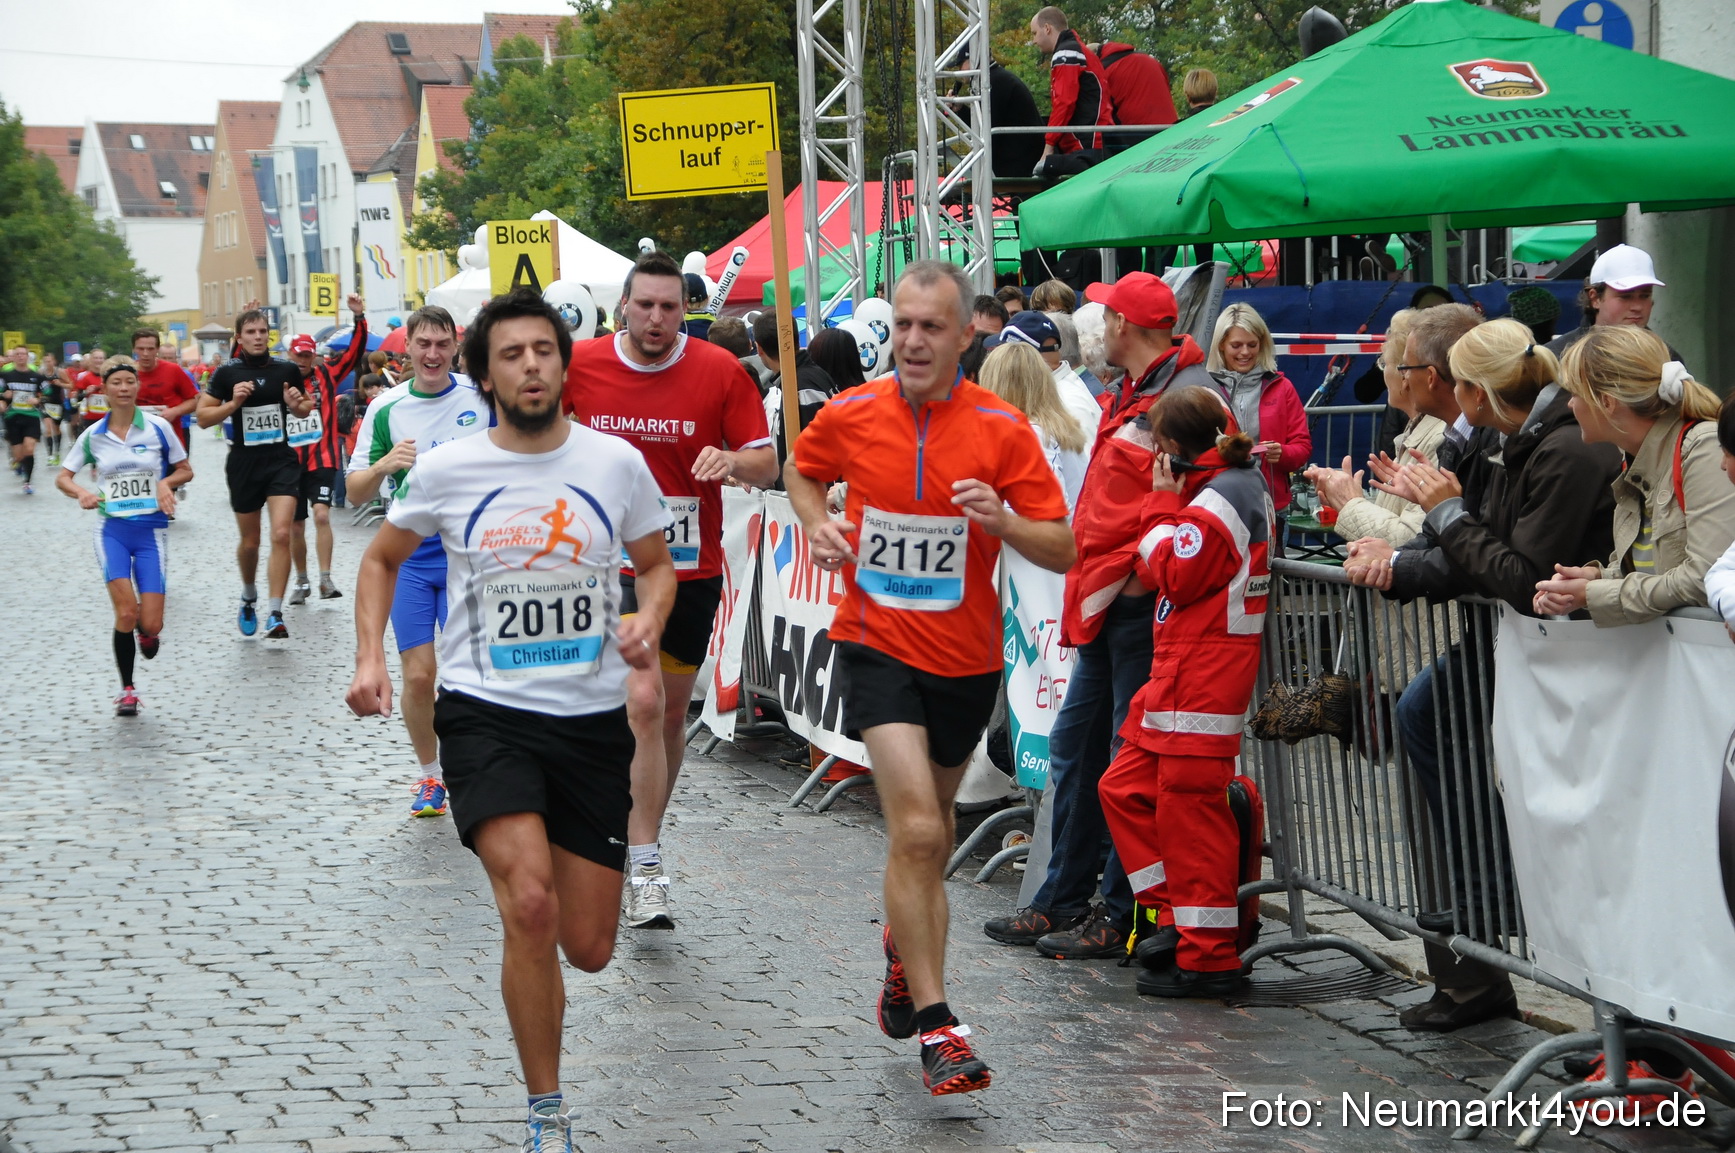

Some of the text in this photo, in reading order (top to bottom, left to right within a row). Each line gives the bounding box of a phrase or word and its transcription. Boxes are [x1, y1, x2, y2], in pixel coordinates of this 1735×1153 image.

[1496, 87, 1532, 98] 1628
[1426, 105, 1632, 129] Neumarkter
[632, 119, 765, 143] Schnupper-
[1398, 120, 1692, 152] Lammsbräu
[679, 146, 722, 168] lauf
[495, 224, 551, 245] Block
[312, 274, 336, 283] Block
[509, 253, 543, 294] A
[317, 286, 332, 307] B
[246, 414, 280, 431] 2446
[287, 418, 318, 434] 2174
[590, 415, 679, 434] NEUMARKT
[110, 479, 151, 499] 2804
[319, 486, 330, 495] 18
[482, 525, 543, 539] MAISEL'S
[865, 515, 949, 535] PARTL Neumarkt
[479, 534, 545, 551] FunRun
[869, 533, 956, 573] 2112
[486, 580, 583, 594] PARTL Neumarkt
[883, 578, 933, 596] Johann
[497, 594, 593, 640] 2018
[511, 644, 581, 666] Christian
